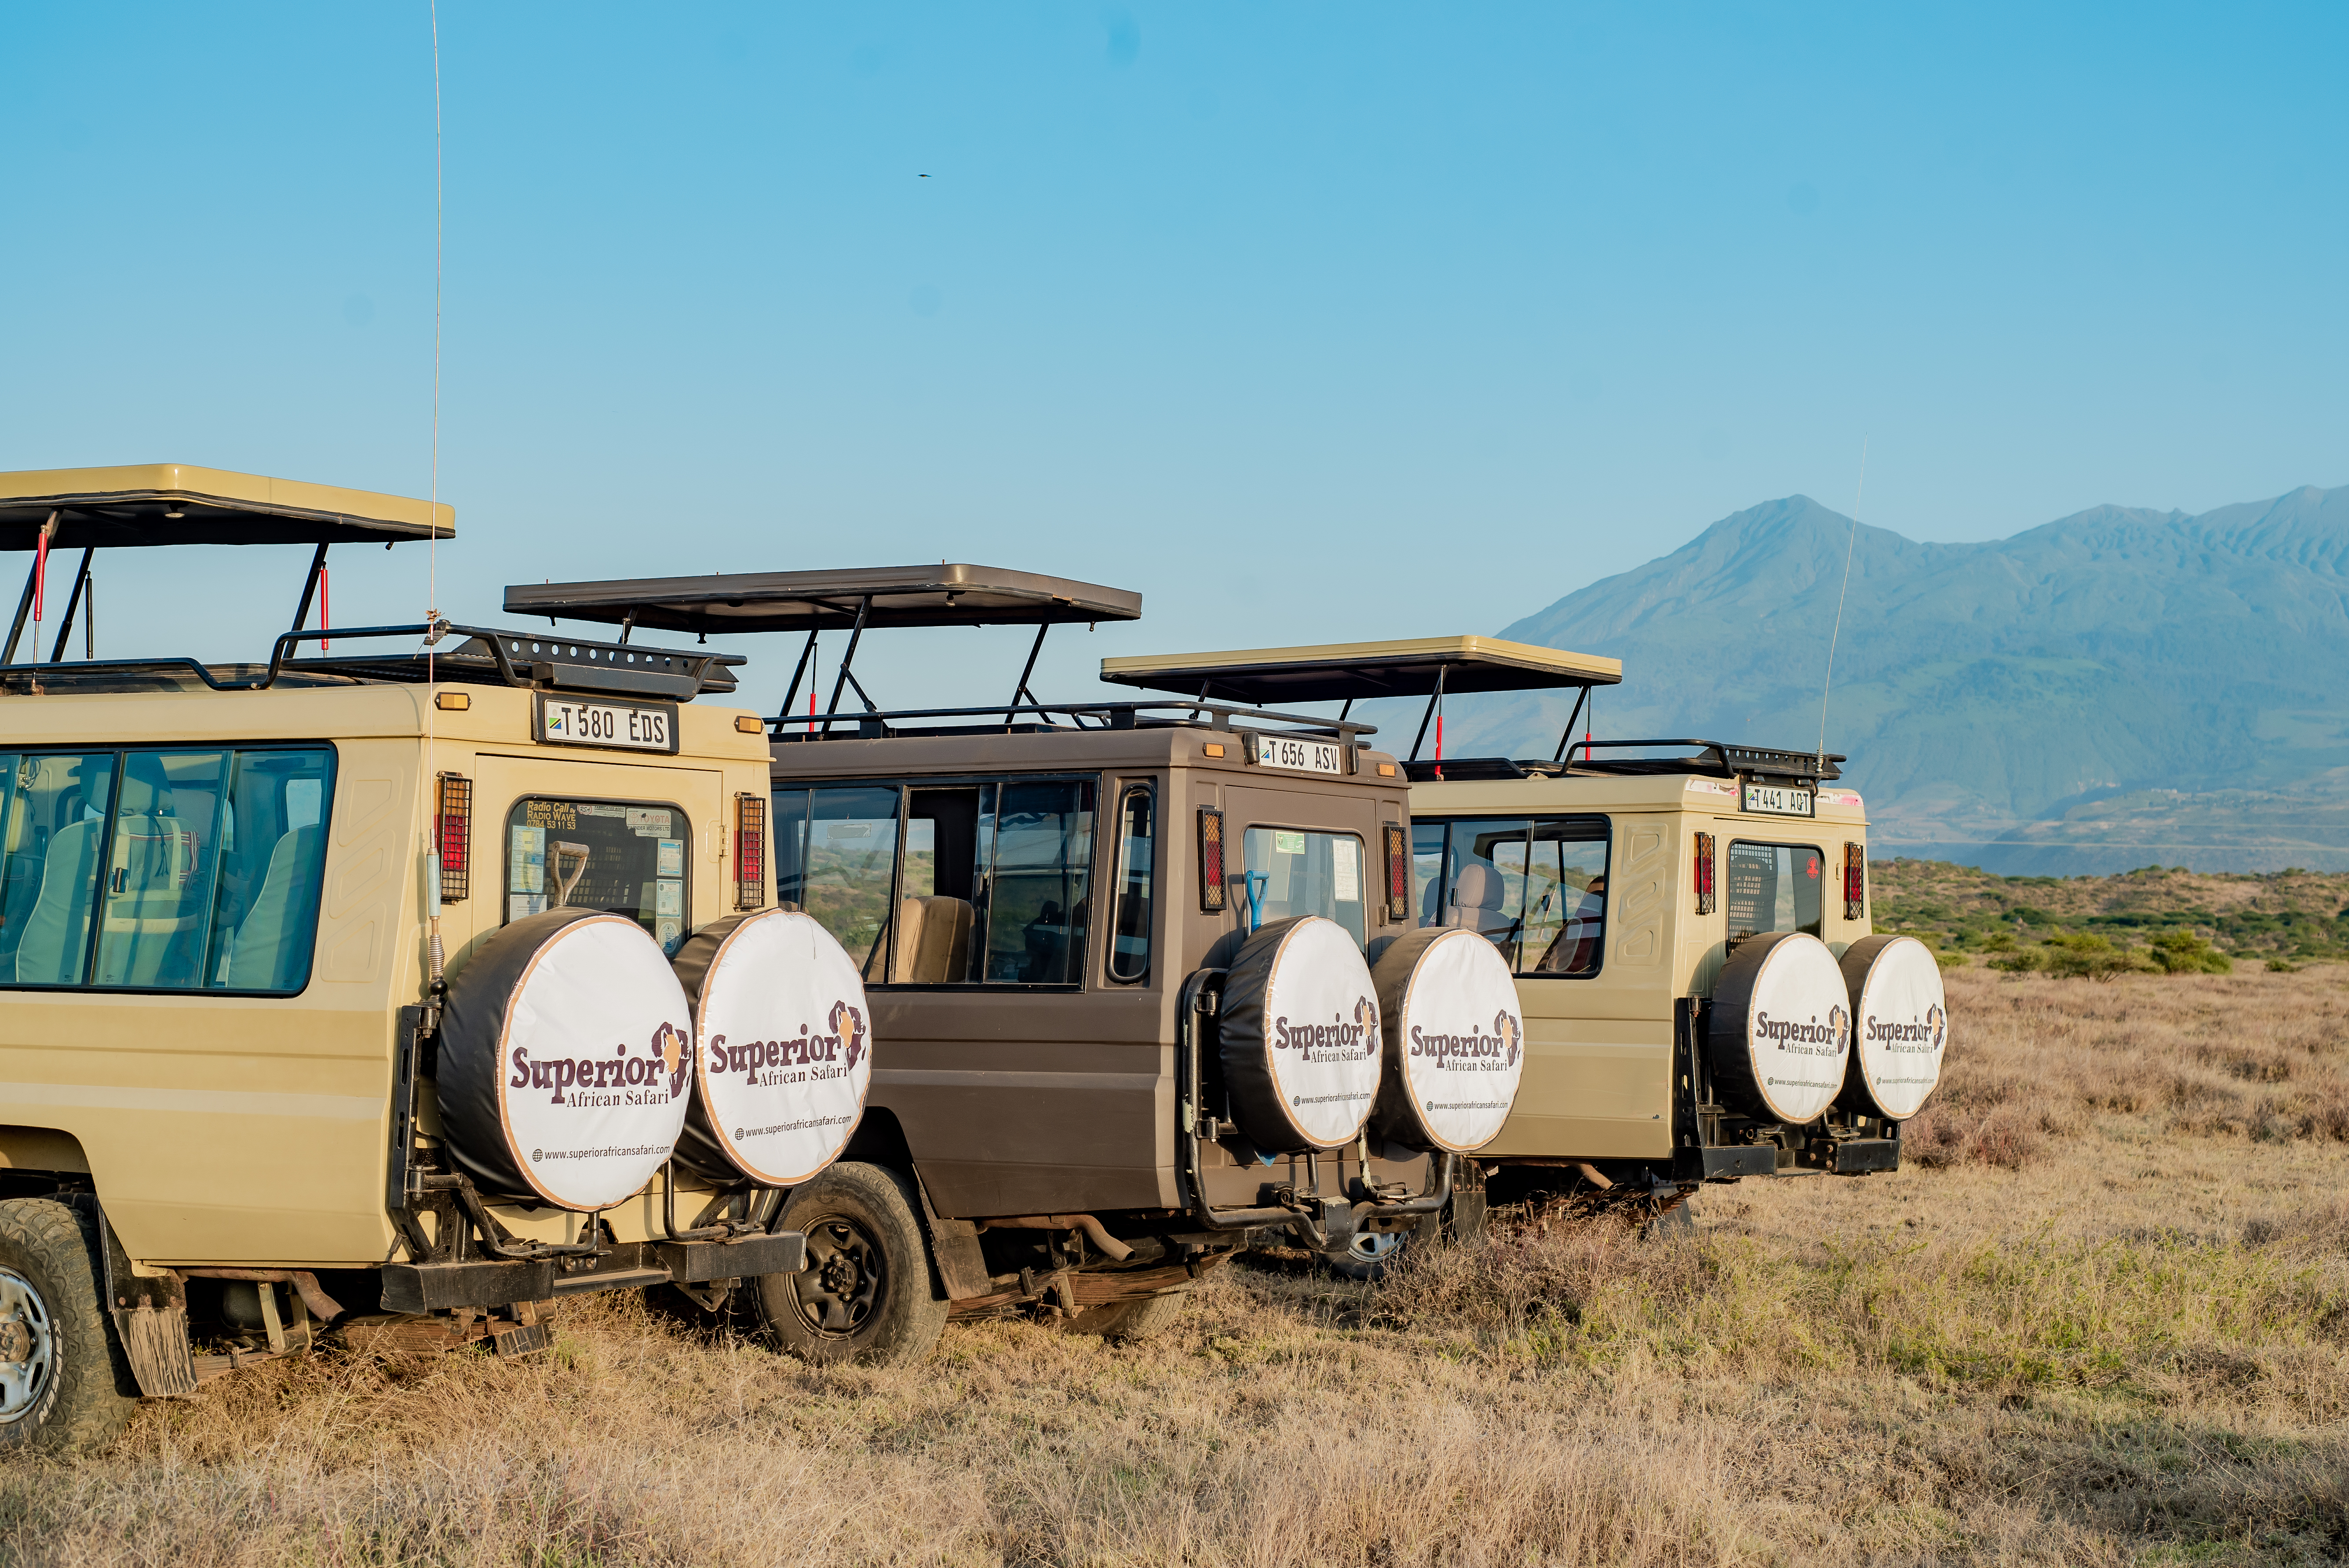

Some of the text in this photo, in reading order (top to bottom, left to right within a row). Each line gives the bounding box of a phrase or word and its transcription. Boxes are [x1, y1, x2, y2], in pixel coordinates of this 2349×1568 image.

[562, 707, 664, 743] T 580 EDS
[1269, 740, 1336, 770] T 656 ASV
[527, 801, 569, 813] Radio Call
[1754, 788, 1808, 812] T 441 AQT
[526, 819, 576, 830] 0784 53 11 53
[527, 810, 576, 821] RADIO WAVE
[639, 814, 670, 824] TOYOTA
[1275, 1013, 1364, 1061] Superior
[1756, 1011, 1835, 1050] Superior
[1866, 1015, 1932, 1050] Superior
[710, 1023, 841, 1085] Superior
[1311, 1048, 1366, 1063] African Safari
[1411, 1025, 1503, 1068] Superior
[1786, 1043, 1837, 1057] African Safari
[1891, 1043, 1915, 1053] African
[511, 1044, 665, 1104] Superior
[1445, 1059, 1507, 1071] African Safari
[760, 1062, 847, 1087] African Safari
[1774, 1079, 1837, 1089] www.superiorafricansafari.com
[567, 1088, 668, 1108] African Safari
[1301, 1091, 1370, 1105] www.superiorafricansafari.com
[1434, 1101, 1508, 1111] www.superiorafricansafari.com
[745, 1115, 851, 1136] www.superiorafricansafari.com
[545, 1144, 670, 1160] www.superiorafricansafari.com
